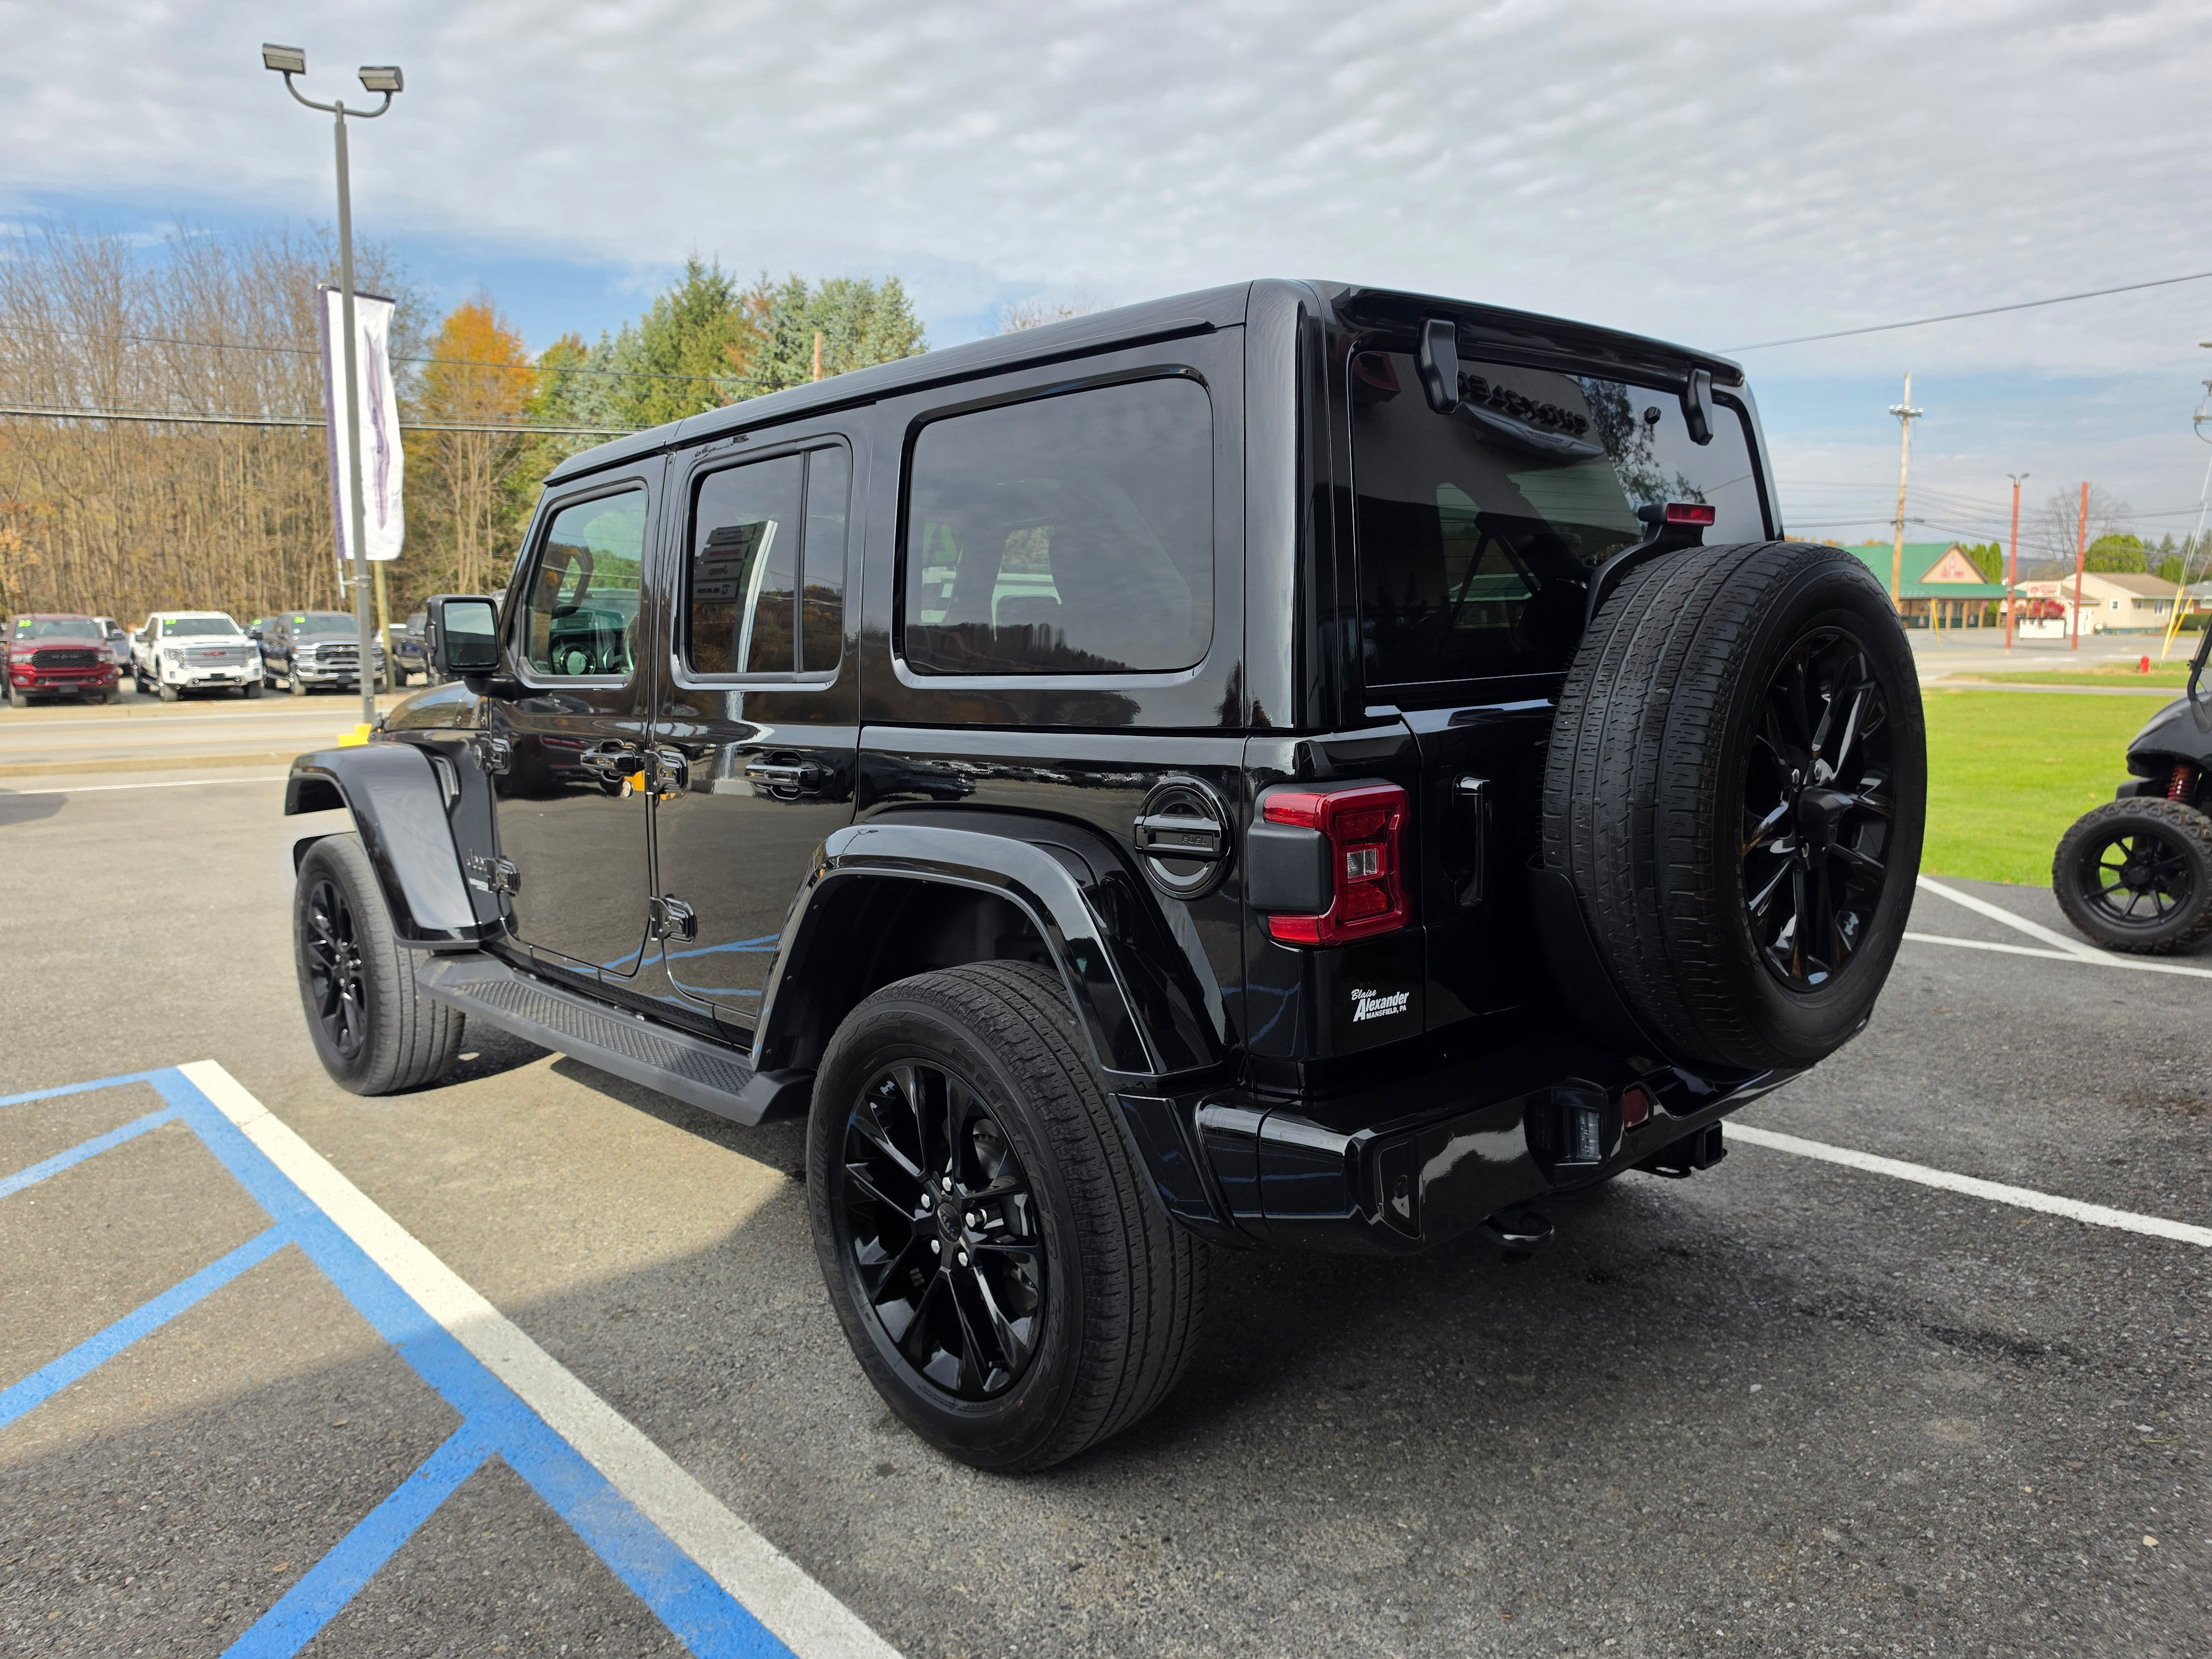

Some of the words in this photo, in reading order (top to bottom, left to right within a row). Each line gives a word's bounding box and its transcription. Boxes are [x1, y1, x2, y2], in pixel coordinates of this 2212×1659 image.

[1181, 834, 1208, 845] FUEL
[1351, 989, 1377, 1000] Blaise
[1353, 992, 1410, 1022] Alexander
[1366, 1007, 1399, 1019] MANSFIELD,
